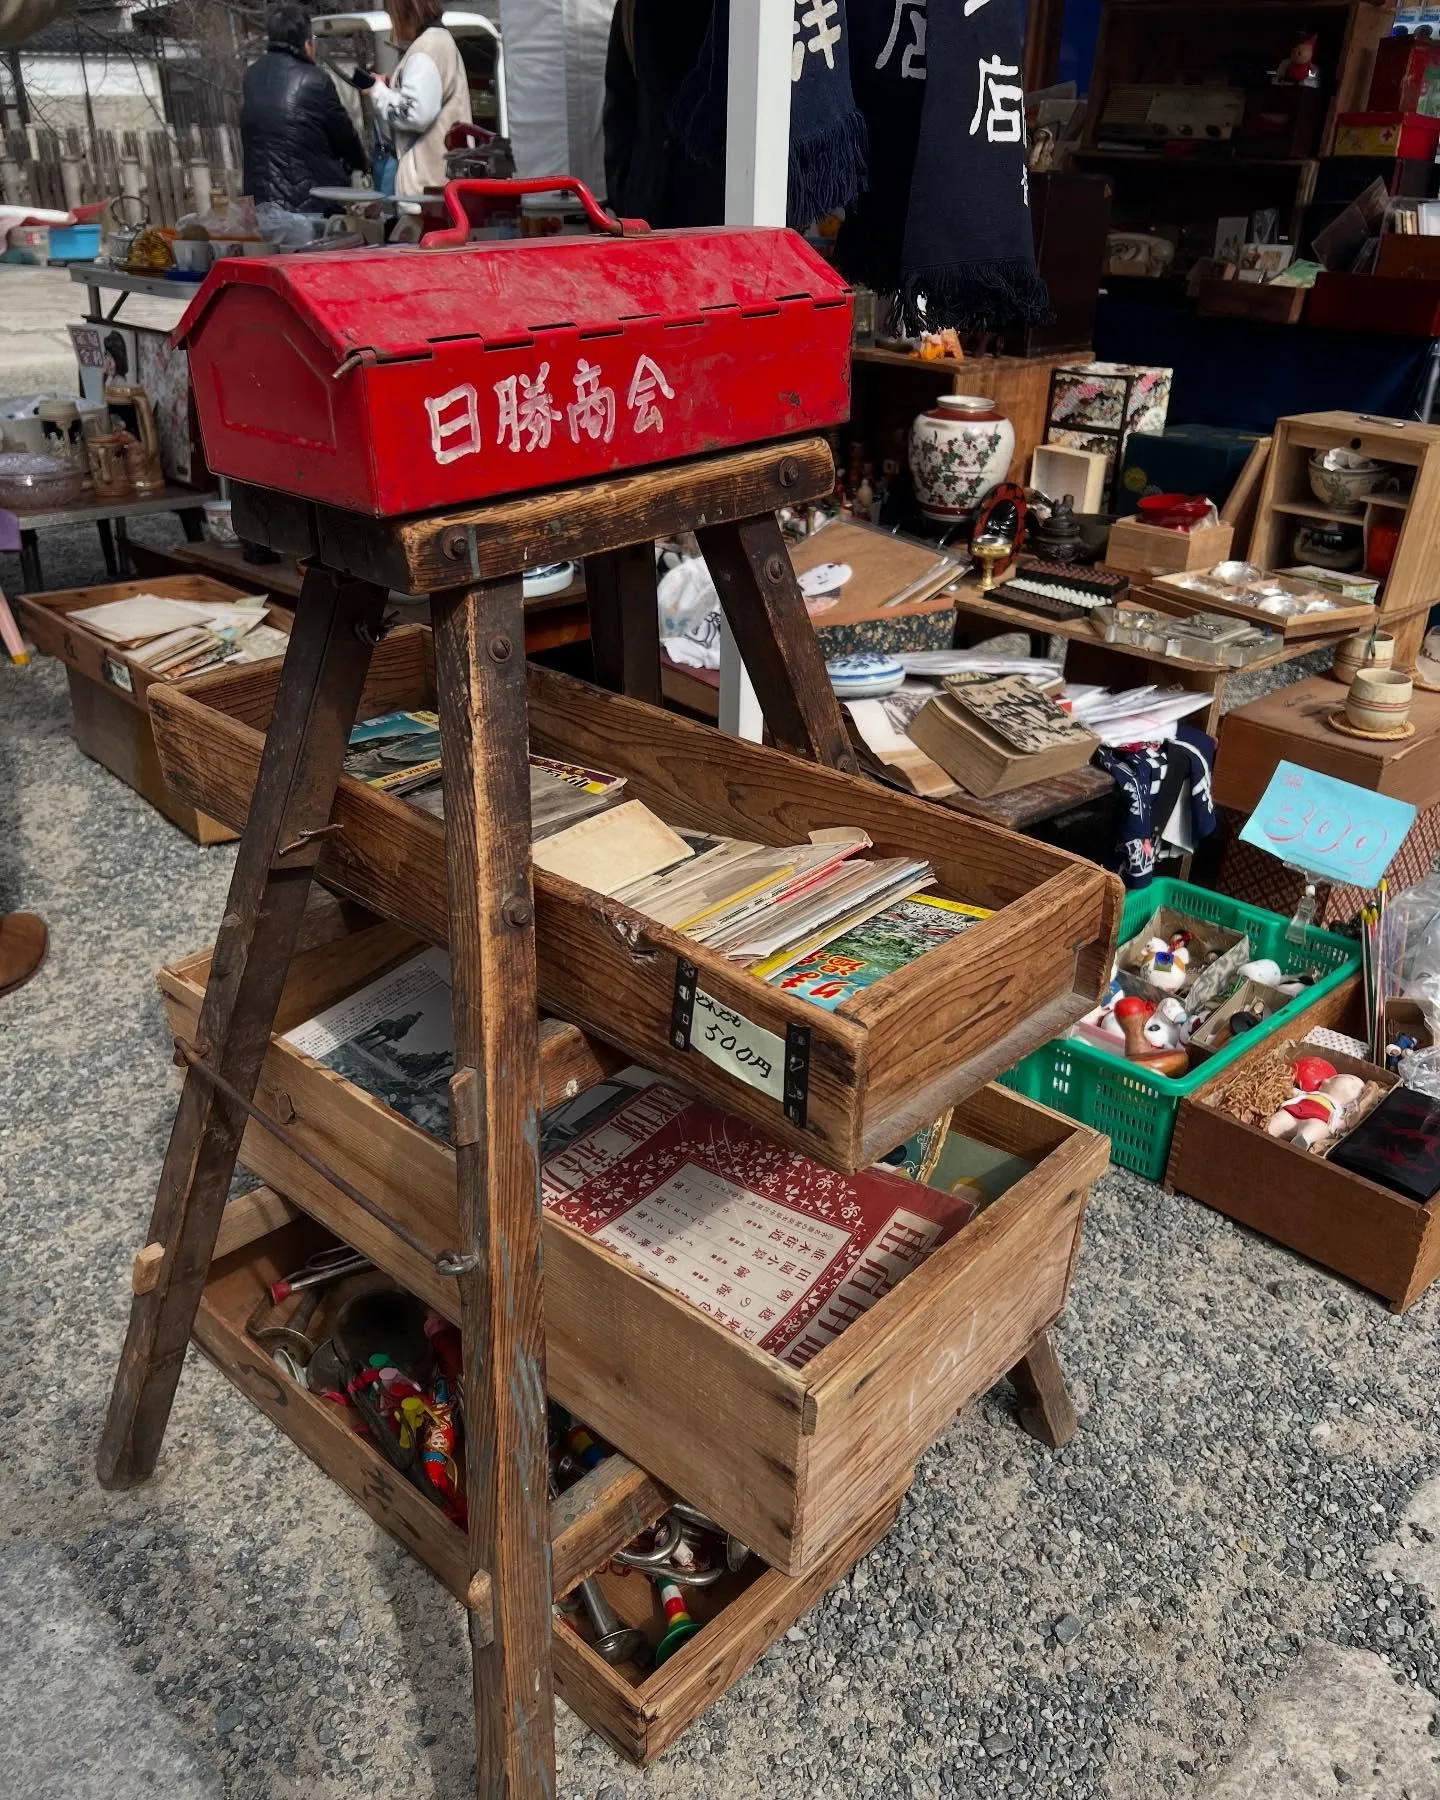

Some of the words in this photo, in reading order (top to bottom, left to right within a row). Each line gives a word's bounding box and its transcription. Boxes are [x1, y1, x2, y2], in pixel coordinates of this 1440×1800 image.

[969, 55, 1022, 142] 店
[424, 354, 675, 465] 日勝商会
[1263, 796, 1387, 865] 300
[705, 1024, 772, 1078] 500円
